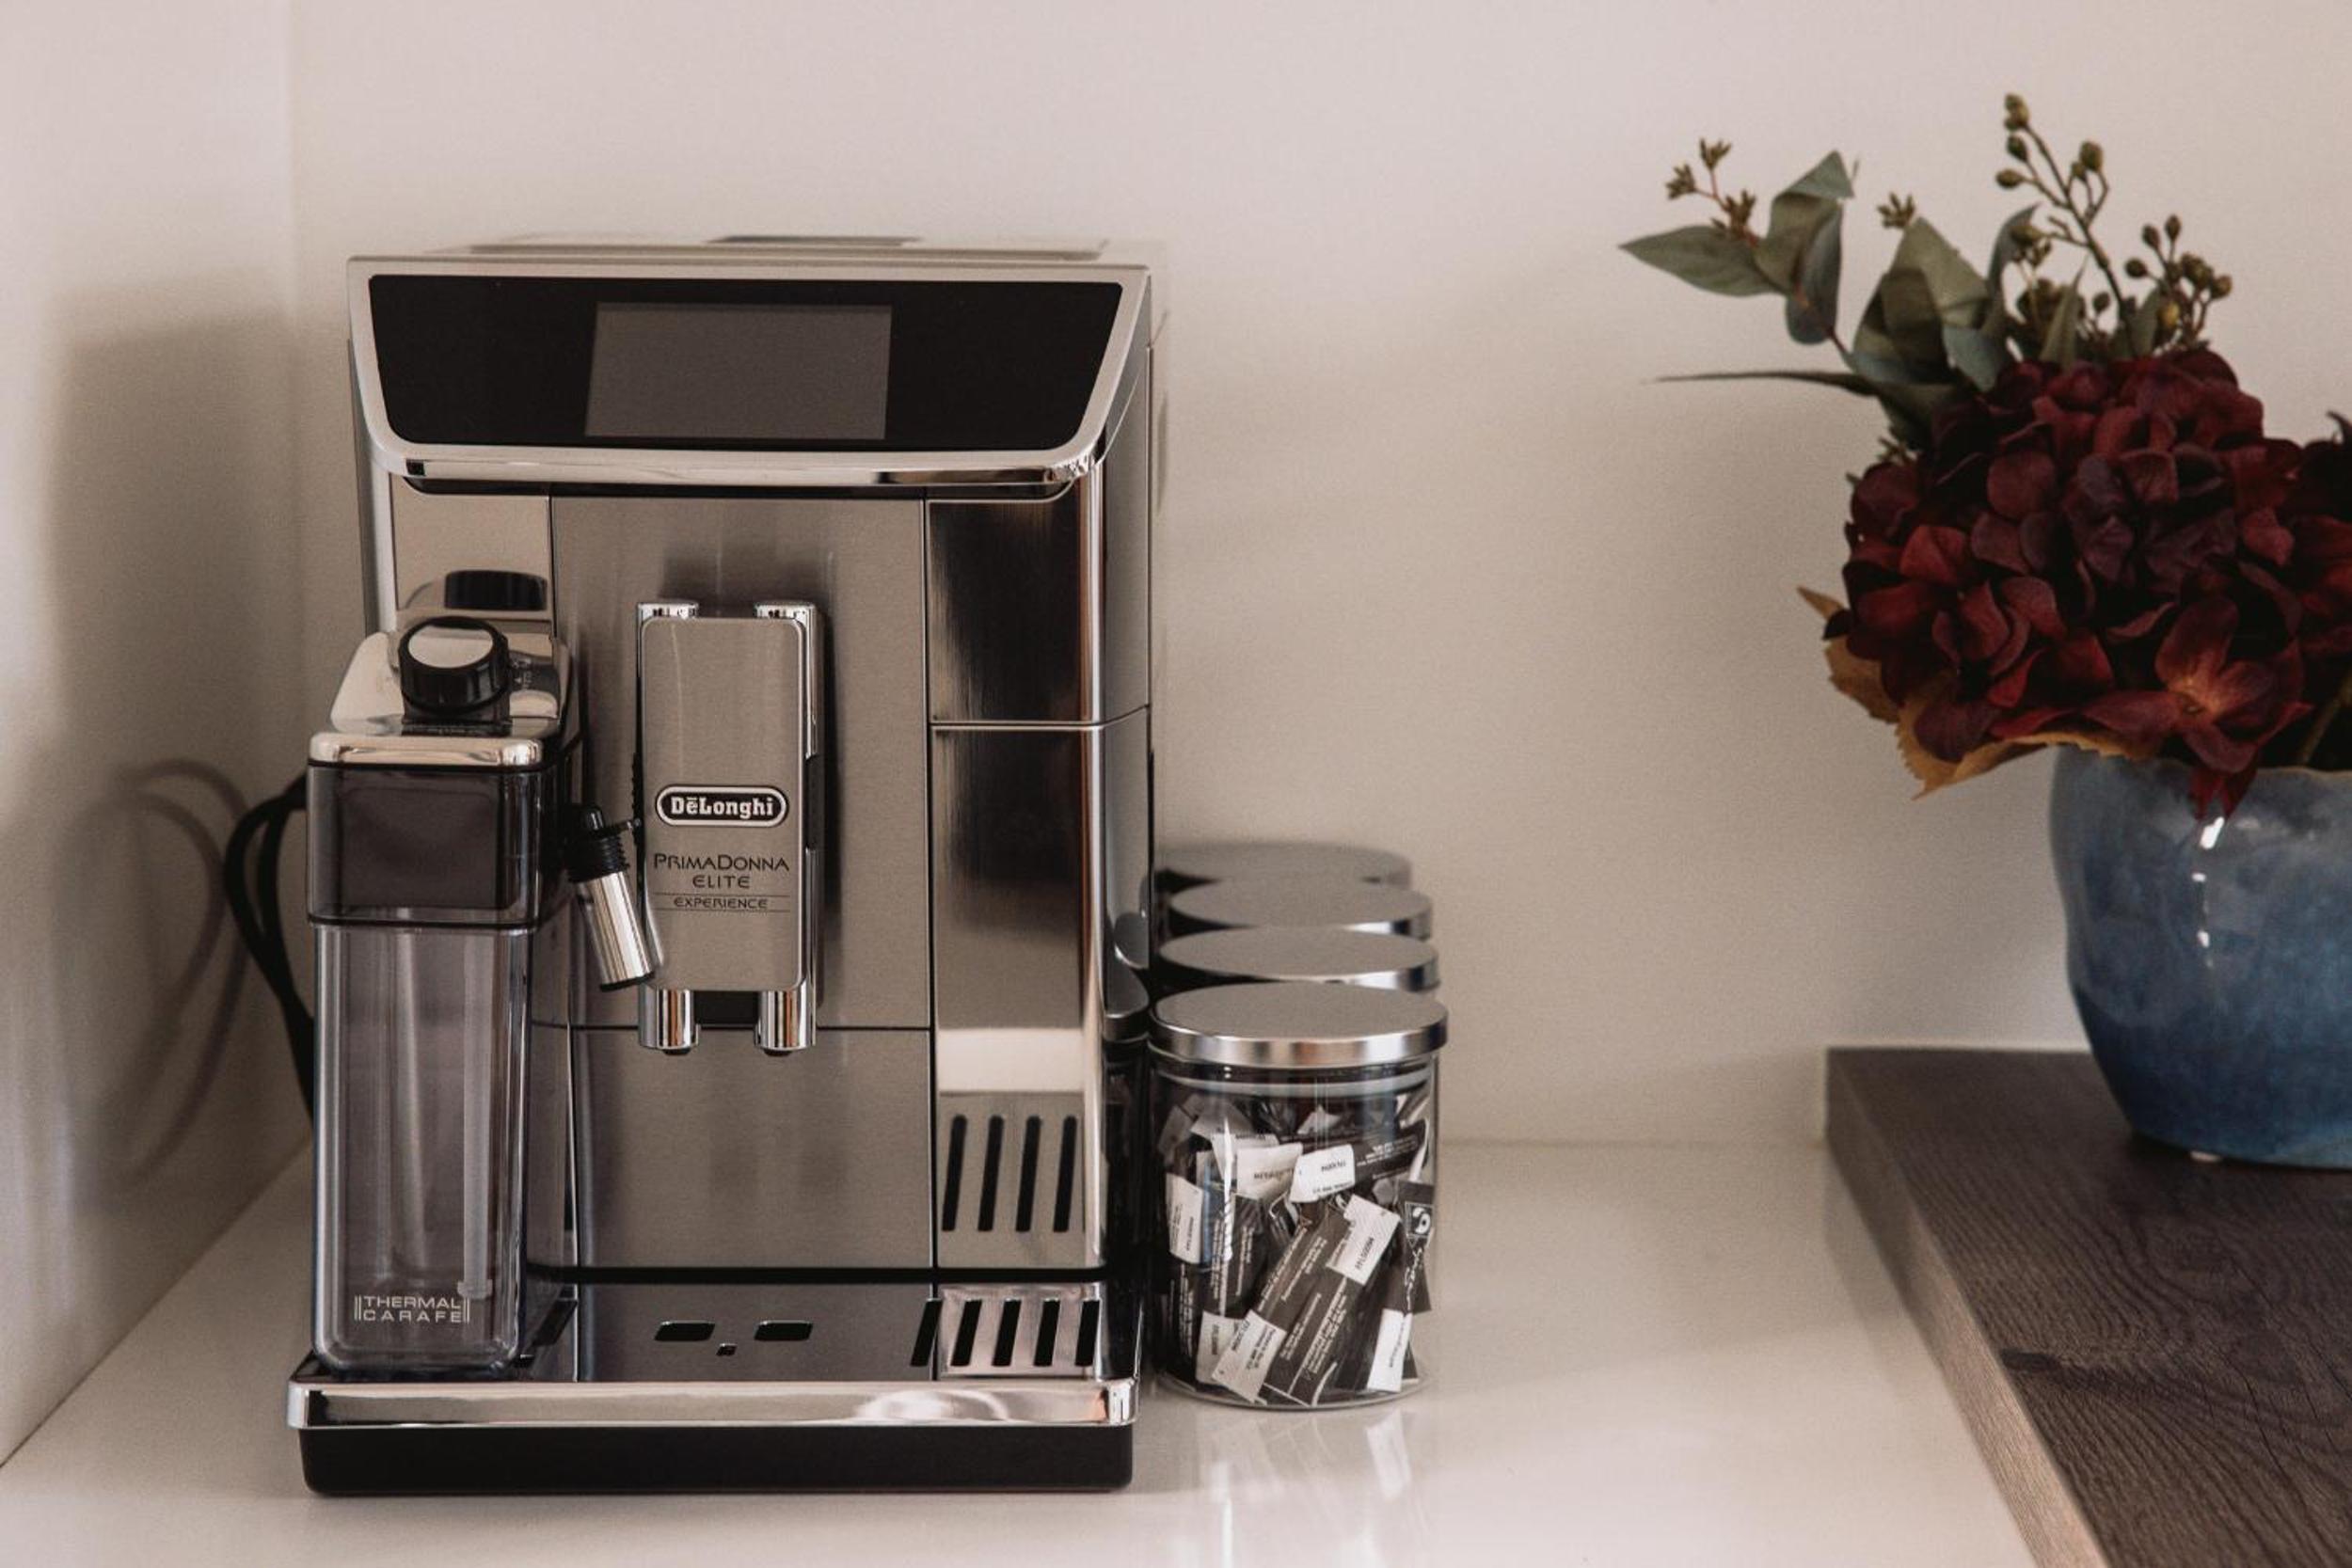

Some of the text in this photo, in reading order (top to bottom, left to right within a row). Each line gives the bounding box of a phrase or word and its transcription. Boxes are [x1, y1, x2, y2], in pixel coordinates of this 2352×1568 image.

[692, 874, 751, 889] ELITE
[674, 896, 768, 909] EXPERIENCE
[363, 1295, 461, 1309] THERMAL
[363, 1309, 462, 1323] CARAFE
